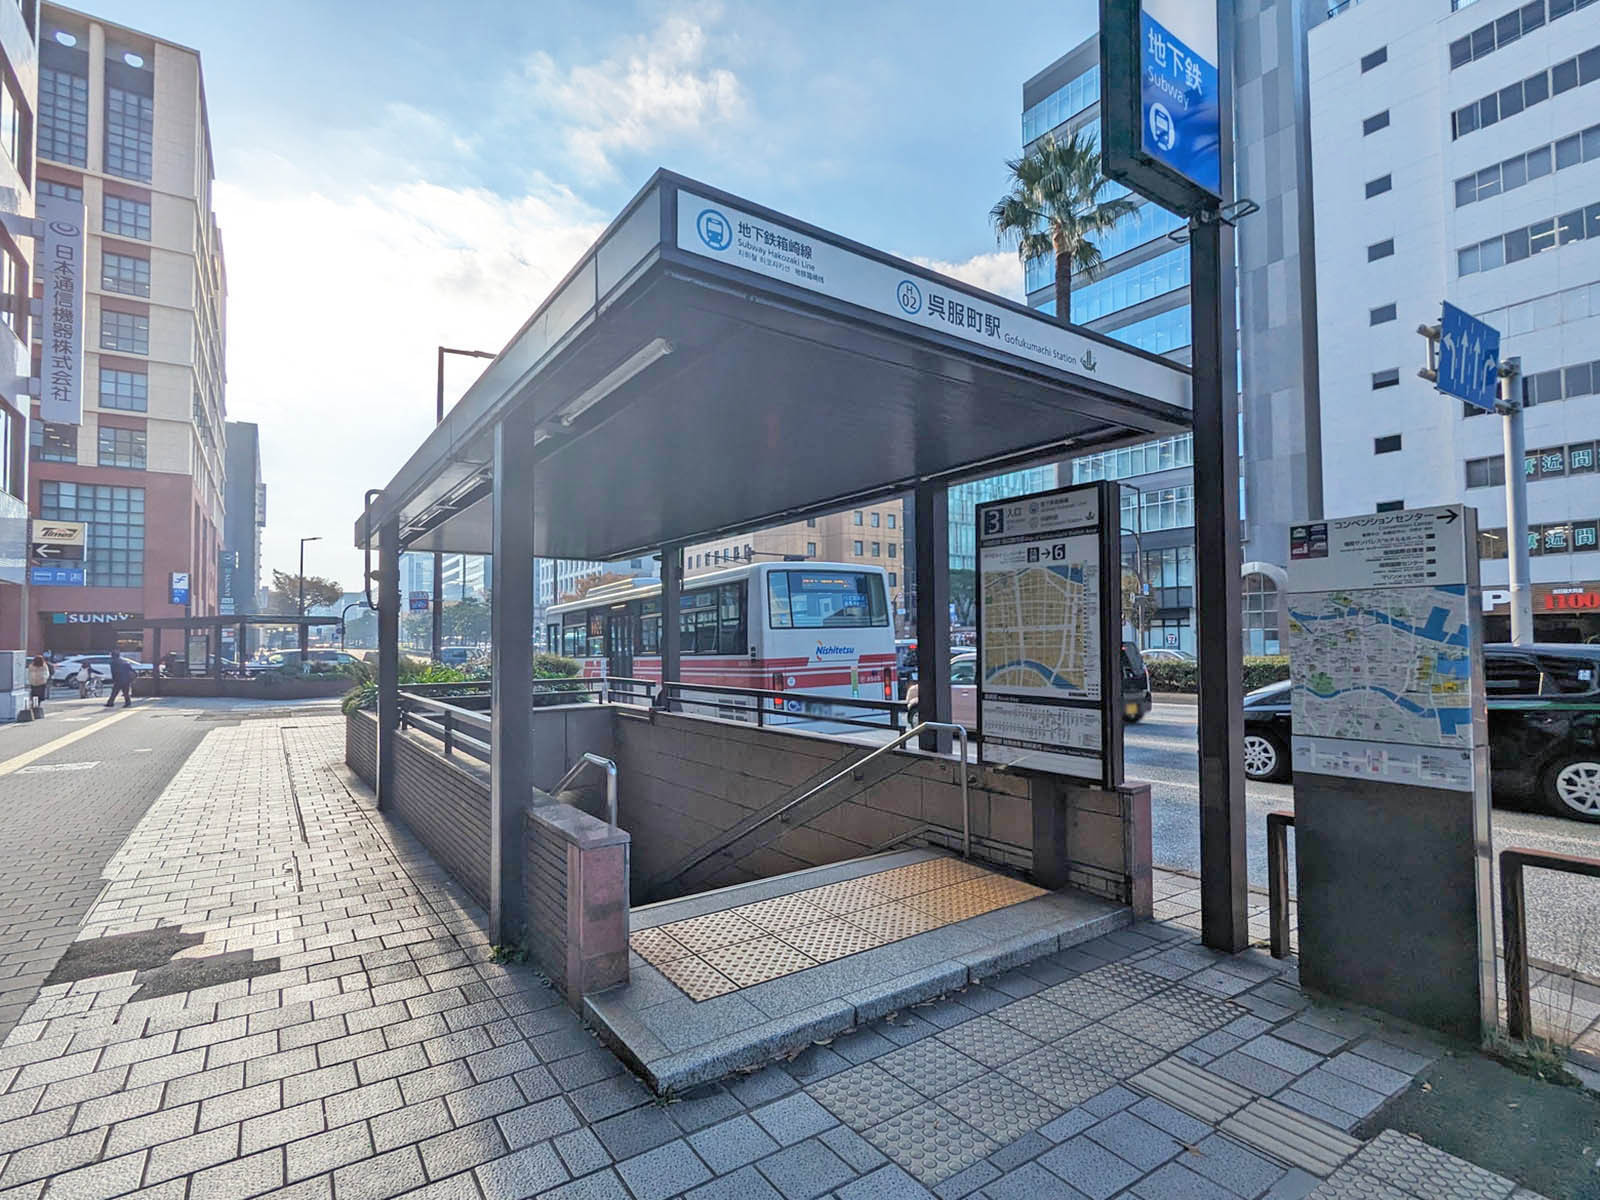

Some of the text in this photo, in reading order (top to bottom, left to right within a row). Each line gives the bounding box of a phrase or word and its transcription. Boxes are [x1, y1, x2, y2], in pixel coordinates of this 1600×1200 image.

[1148, 27, 1203, 96] 地下鉄
[1148, 65, 1190, 111] Subway
[737, 220, 813, 260] 地下鉄箱崎線
[737, 238, 816, 272] Subway Hakozaki Line
[906, 285, 914, 293] H
[902, 294, 917, 310] 02
[52, 244, 74, 402] 日本通信機器株式会社
[927, 293, 1001, 339] 呉服町駅
[1004, 332, 1077, 365] Gofukumachi Station
[988, 509, 1001, 533] 3
[1334, 512, 1435, 530] コンベンションセンター
[41, 527, 78, 538] Times
[1054, 544, 1064, 559] 6
[1482, 590, 1511, 611] P
[69, 613, 128, 623] SUNNY
[816, 645, 855, 655] Nishitetsu
